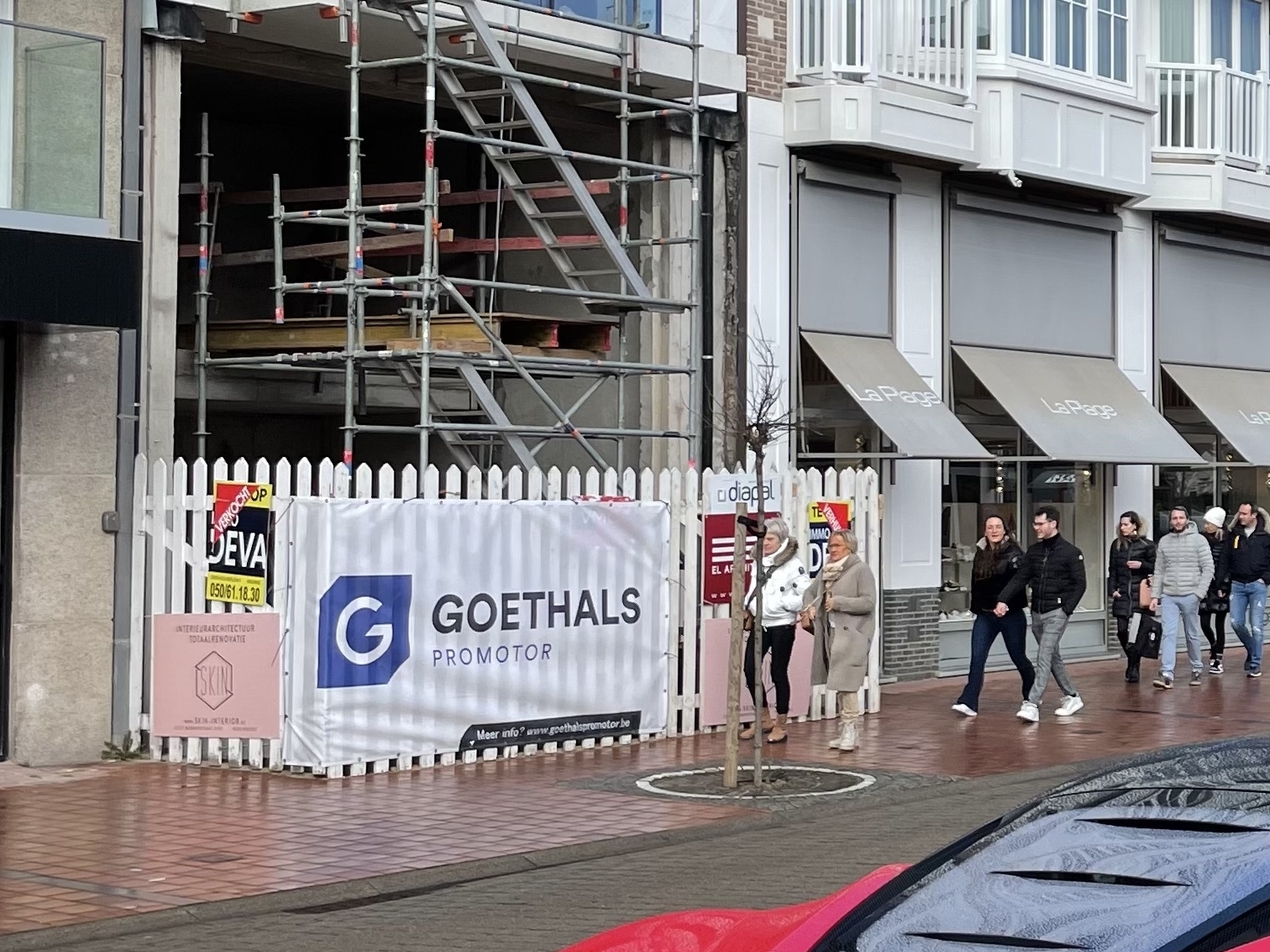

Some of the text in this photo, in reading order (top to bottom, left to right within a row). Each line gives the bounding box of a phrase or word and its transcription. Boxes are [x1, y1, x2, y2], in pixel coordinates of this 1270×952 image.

[214, 485, 252, 533] VERKOCHT
[208, 530, 266, 569] DEVA
[210, 582, 260, 603] 050/61.18.30
[432, 587, 641, 634] GOETHALS
[433, 643, 553, 667] PROMOTOR
[200, 665, 229, 696] SKIN
[476, 717, 631, 741] Meer info? www.goethalspromotor.be
